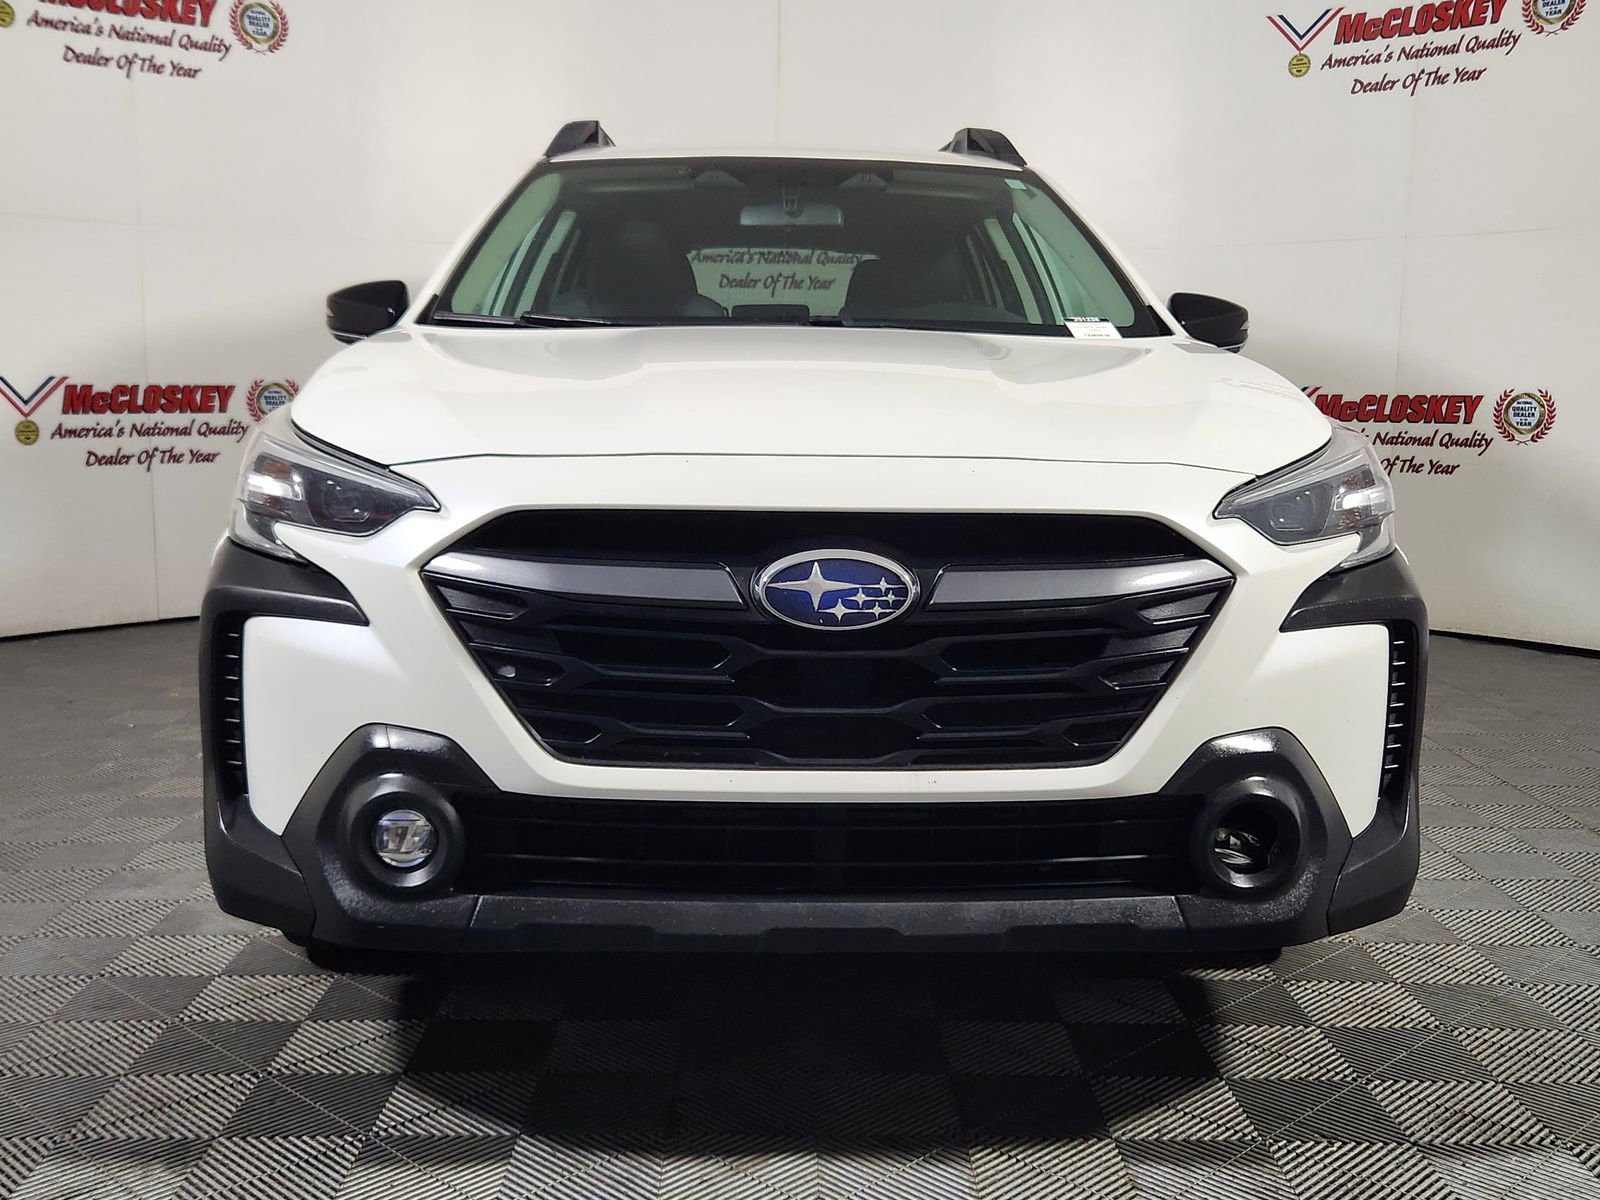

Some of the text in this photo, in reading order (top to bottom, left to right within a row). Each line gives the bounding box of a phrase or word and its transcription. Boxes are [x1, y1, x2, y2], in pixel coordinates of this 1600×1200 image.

[27, 10, 232, 61] America's National Quality
[1333, 0, 1507, 45] McCLOSKEY
[62, 45, 202, 79] Dealer Of The Year
[1320, 28, 1522, 71] America's National Quality
[1350, 66, 1488, 97] Dealer Of The Year
[719, 272, 837, 299] Dealer Of The Year
[61, 384, 236, 415] McCLOSKEY
[1314, 394, 1484, 424] McCLOSKEY
[51, 418, 250, 443] America's National Quality
[1372, 428, 1436, 448] National
[1438, 428, 1494, 457] Quality
[85, 446, 221, 473] Dealer Of The Year
[1399, 455, 1426, 474] The
[1427, 458, 1461, 476] Year
